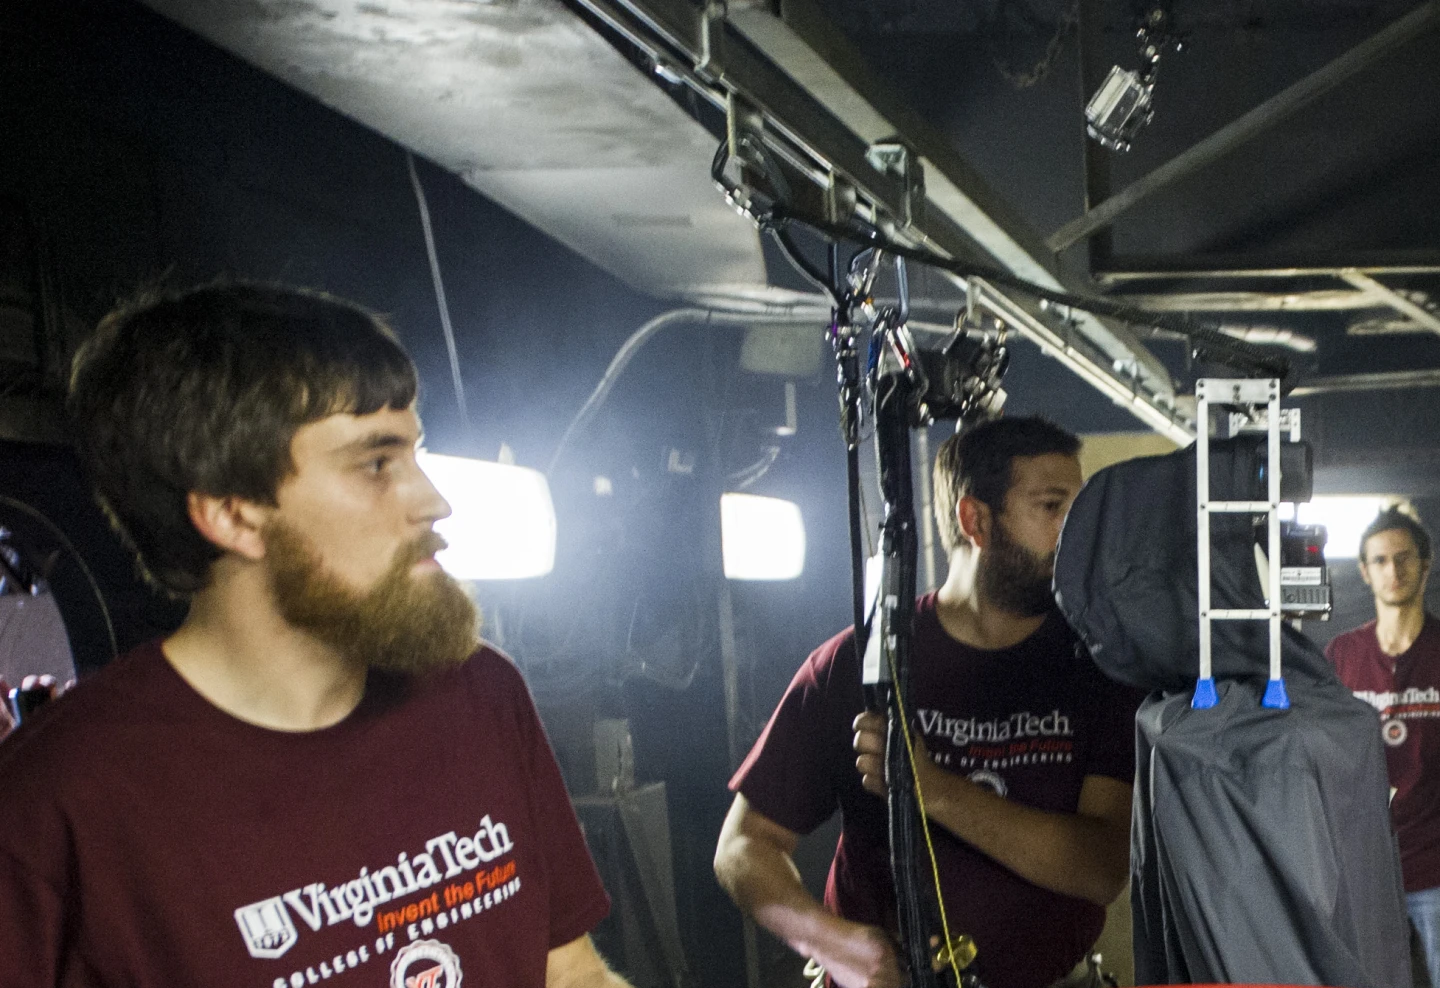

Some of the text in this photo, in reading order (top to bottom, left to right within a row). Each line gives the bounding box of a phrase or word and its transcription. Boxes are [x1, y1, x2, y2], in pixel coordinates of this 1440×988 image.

[376, 890, 440, 933] Invent
[443, 881, 475, 908] the
[375, 931, 395, 955] OF
